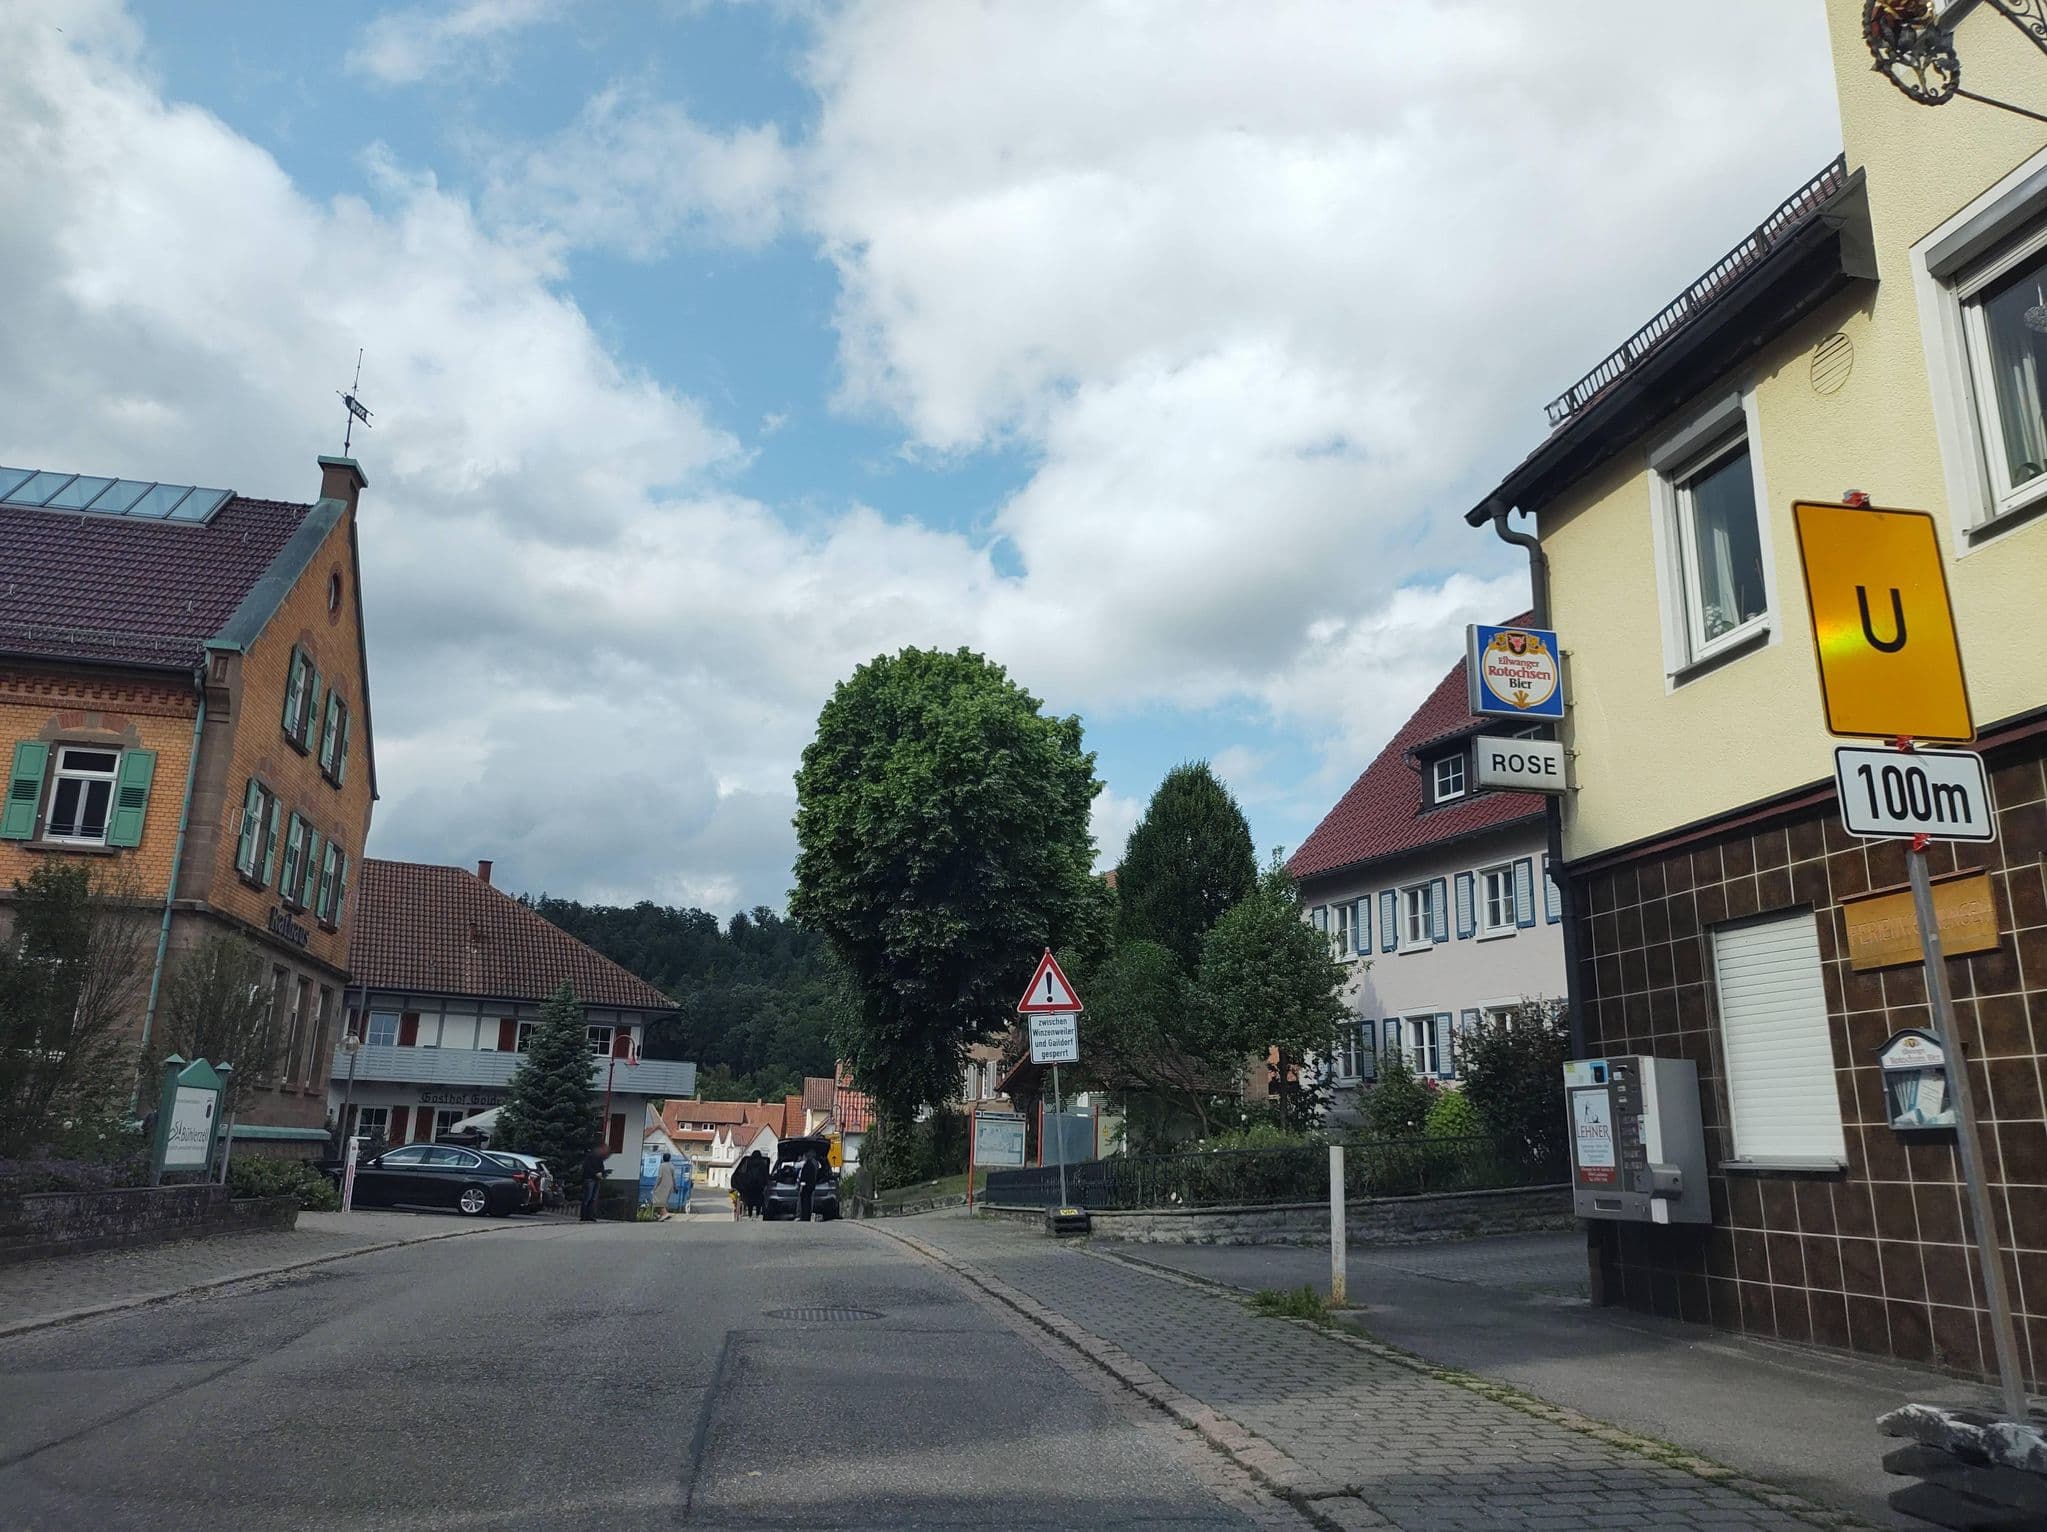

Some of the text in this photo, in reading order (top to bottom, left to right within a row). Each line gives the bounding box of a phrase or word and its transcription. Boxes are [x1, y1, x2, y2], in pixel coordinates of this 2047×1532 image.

[1855, 585, 1907, 653] U
[1498, 656, 1540, 670] Ellwanger
[1488, 665, 1551, 680] Rotochsen
[1509, 678, 1532, 689] Bier
[1492, 753, 1557, 775] ROSE
[1857, 763, 1972, 824] 100m
[1038, 1017, 1068, 1027] zwischen
[1033, 1027, 1074, 1037] Winzenweiler
[1035, 1039, 1047, 1048] und
[1041, 1049, 1069, 1060] gesperrt
[1576, 1120, 1612, 1143] LEHNER
